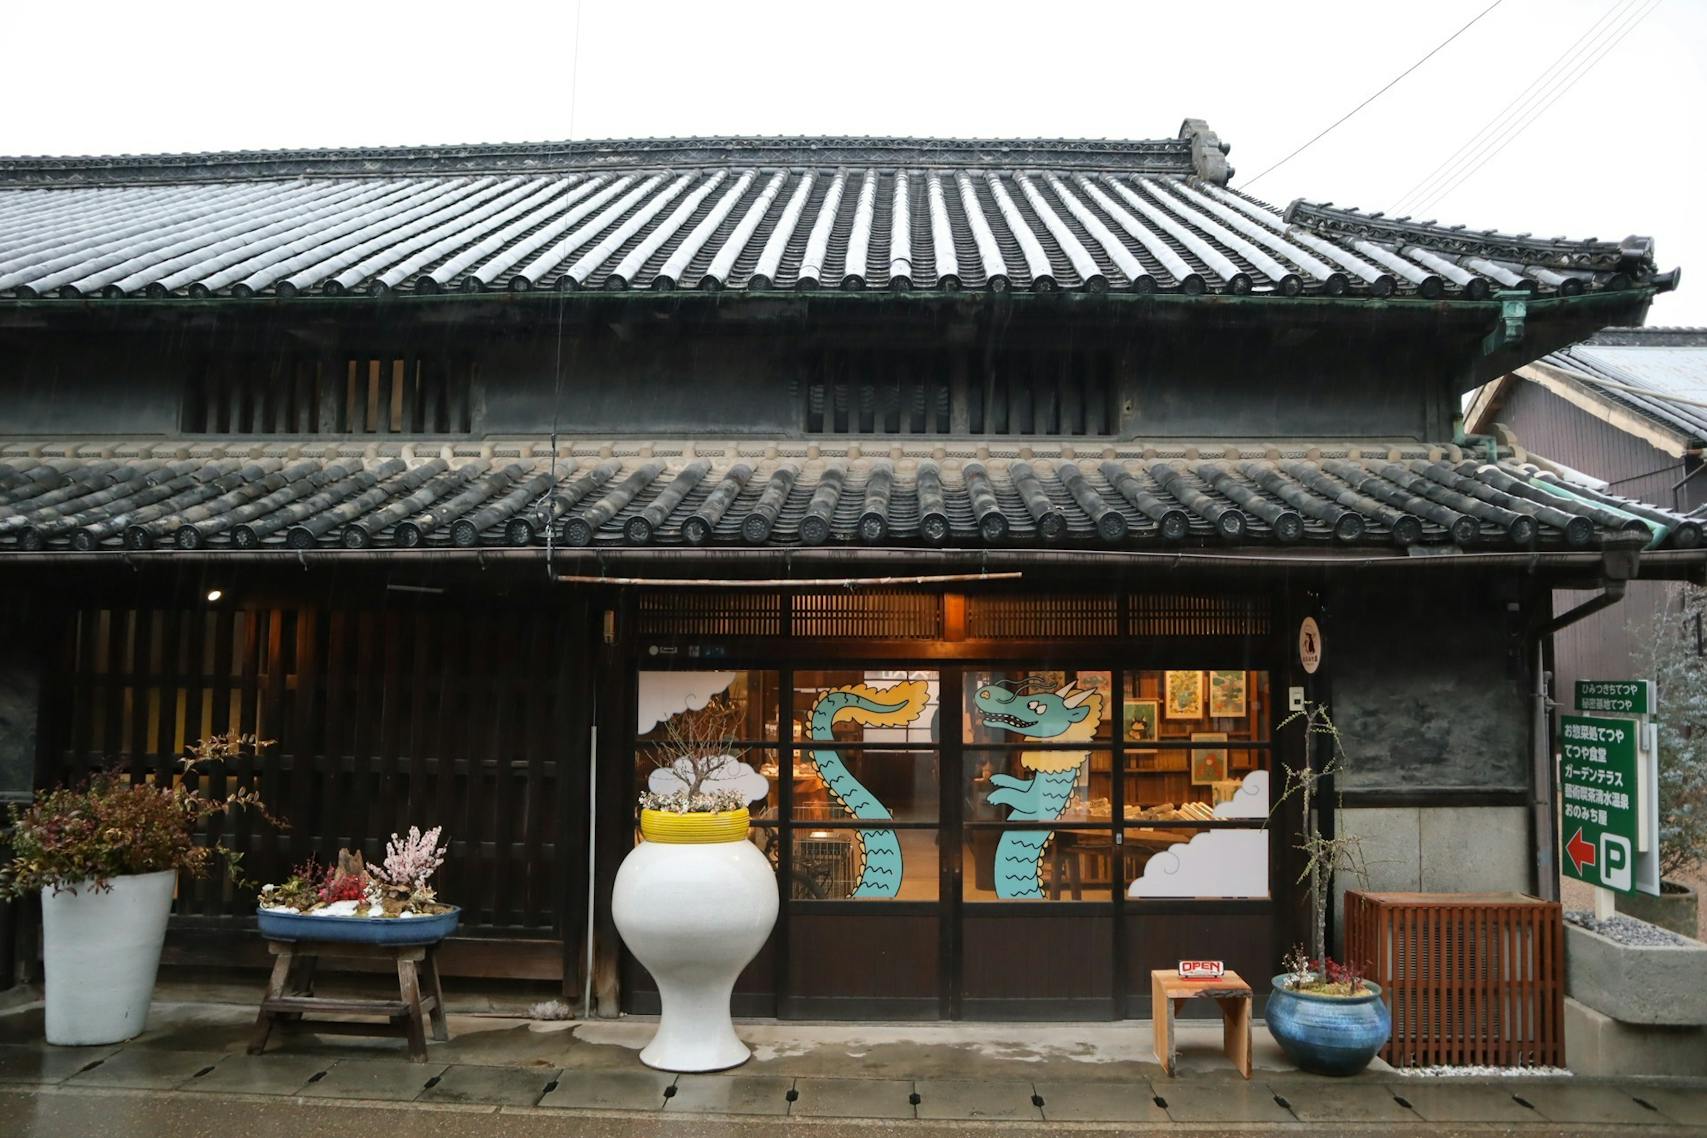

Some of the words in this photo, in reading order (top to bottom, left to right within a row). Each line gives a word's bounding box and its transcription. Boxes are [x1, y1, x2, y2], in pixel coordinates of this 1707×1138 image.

[1564, 744, 1607, 763] てつや食堂
[1565, 763, 1623, 787] ガーデンテラス
[1565, 803, 1607, 826] おのみち屋
[1182, 962, 1220, 972] OPEN
